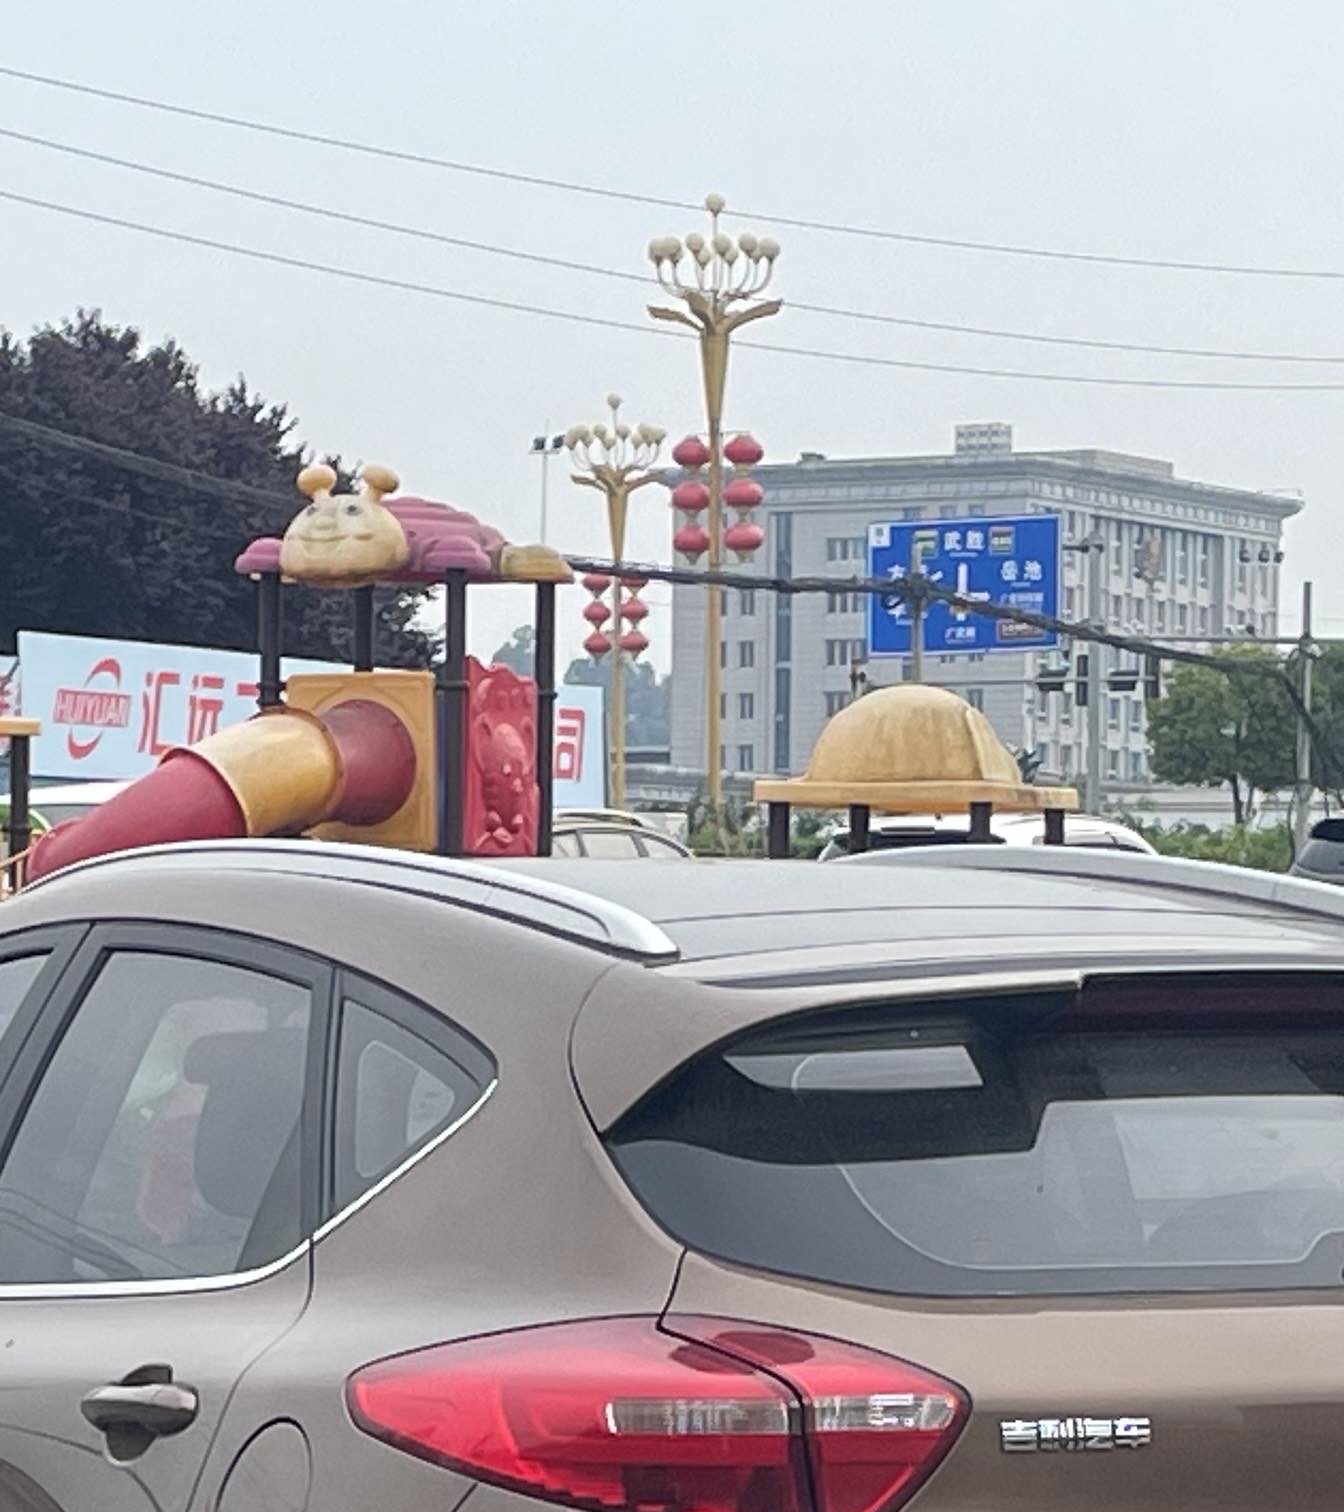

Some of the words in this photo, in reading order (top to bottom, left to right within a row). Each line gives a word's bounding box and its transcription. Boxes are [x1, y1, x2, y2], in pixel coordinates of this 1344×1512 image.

[55, 690, 131, 726] HUIYUAN
[999, 1416, 1152, 1453] 吉利汽车
